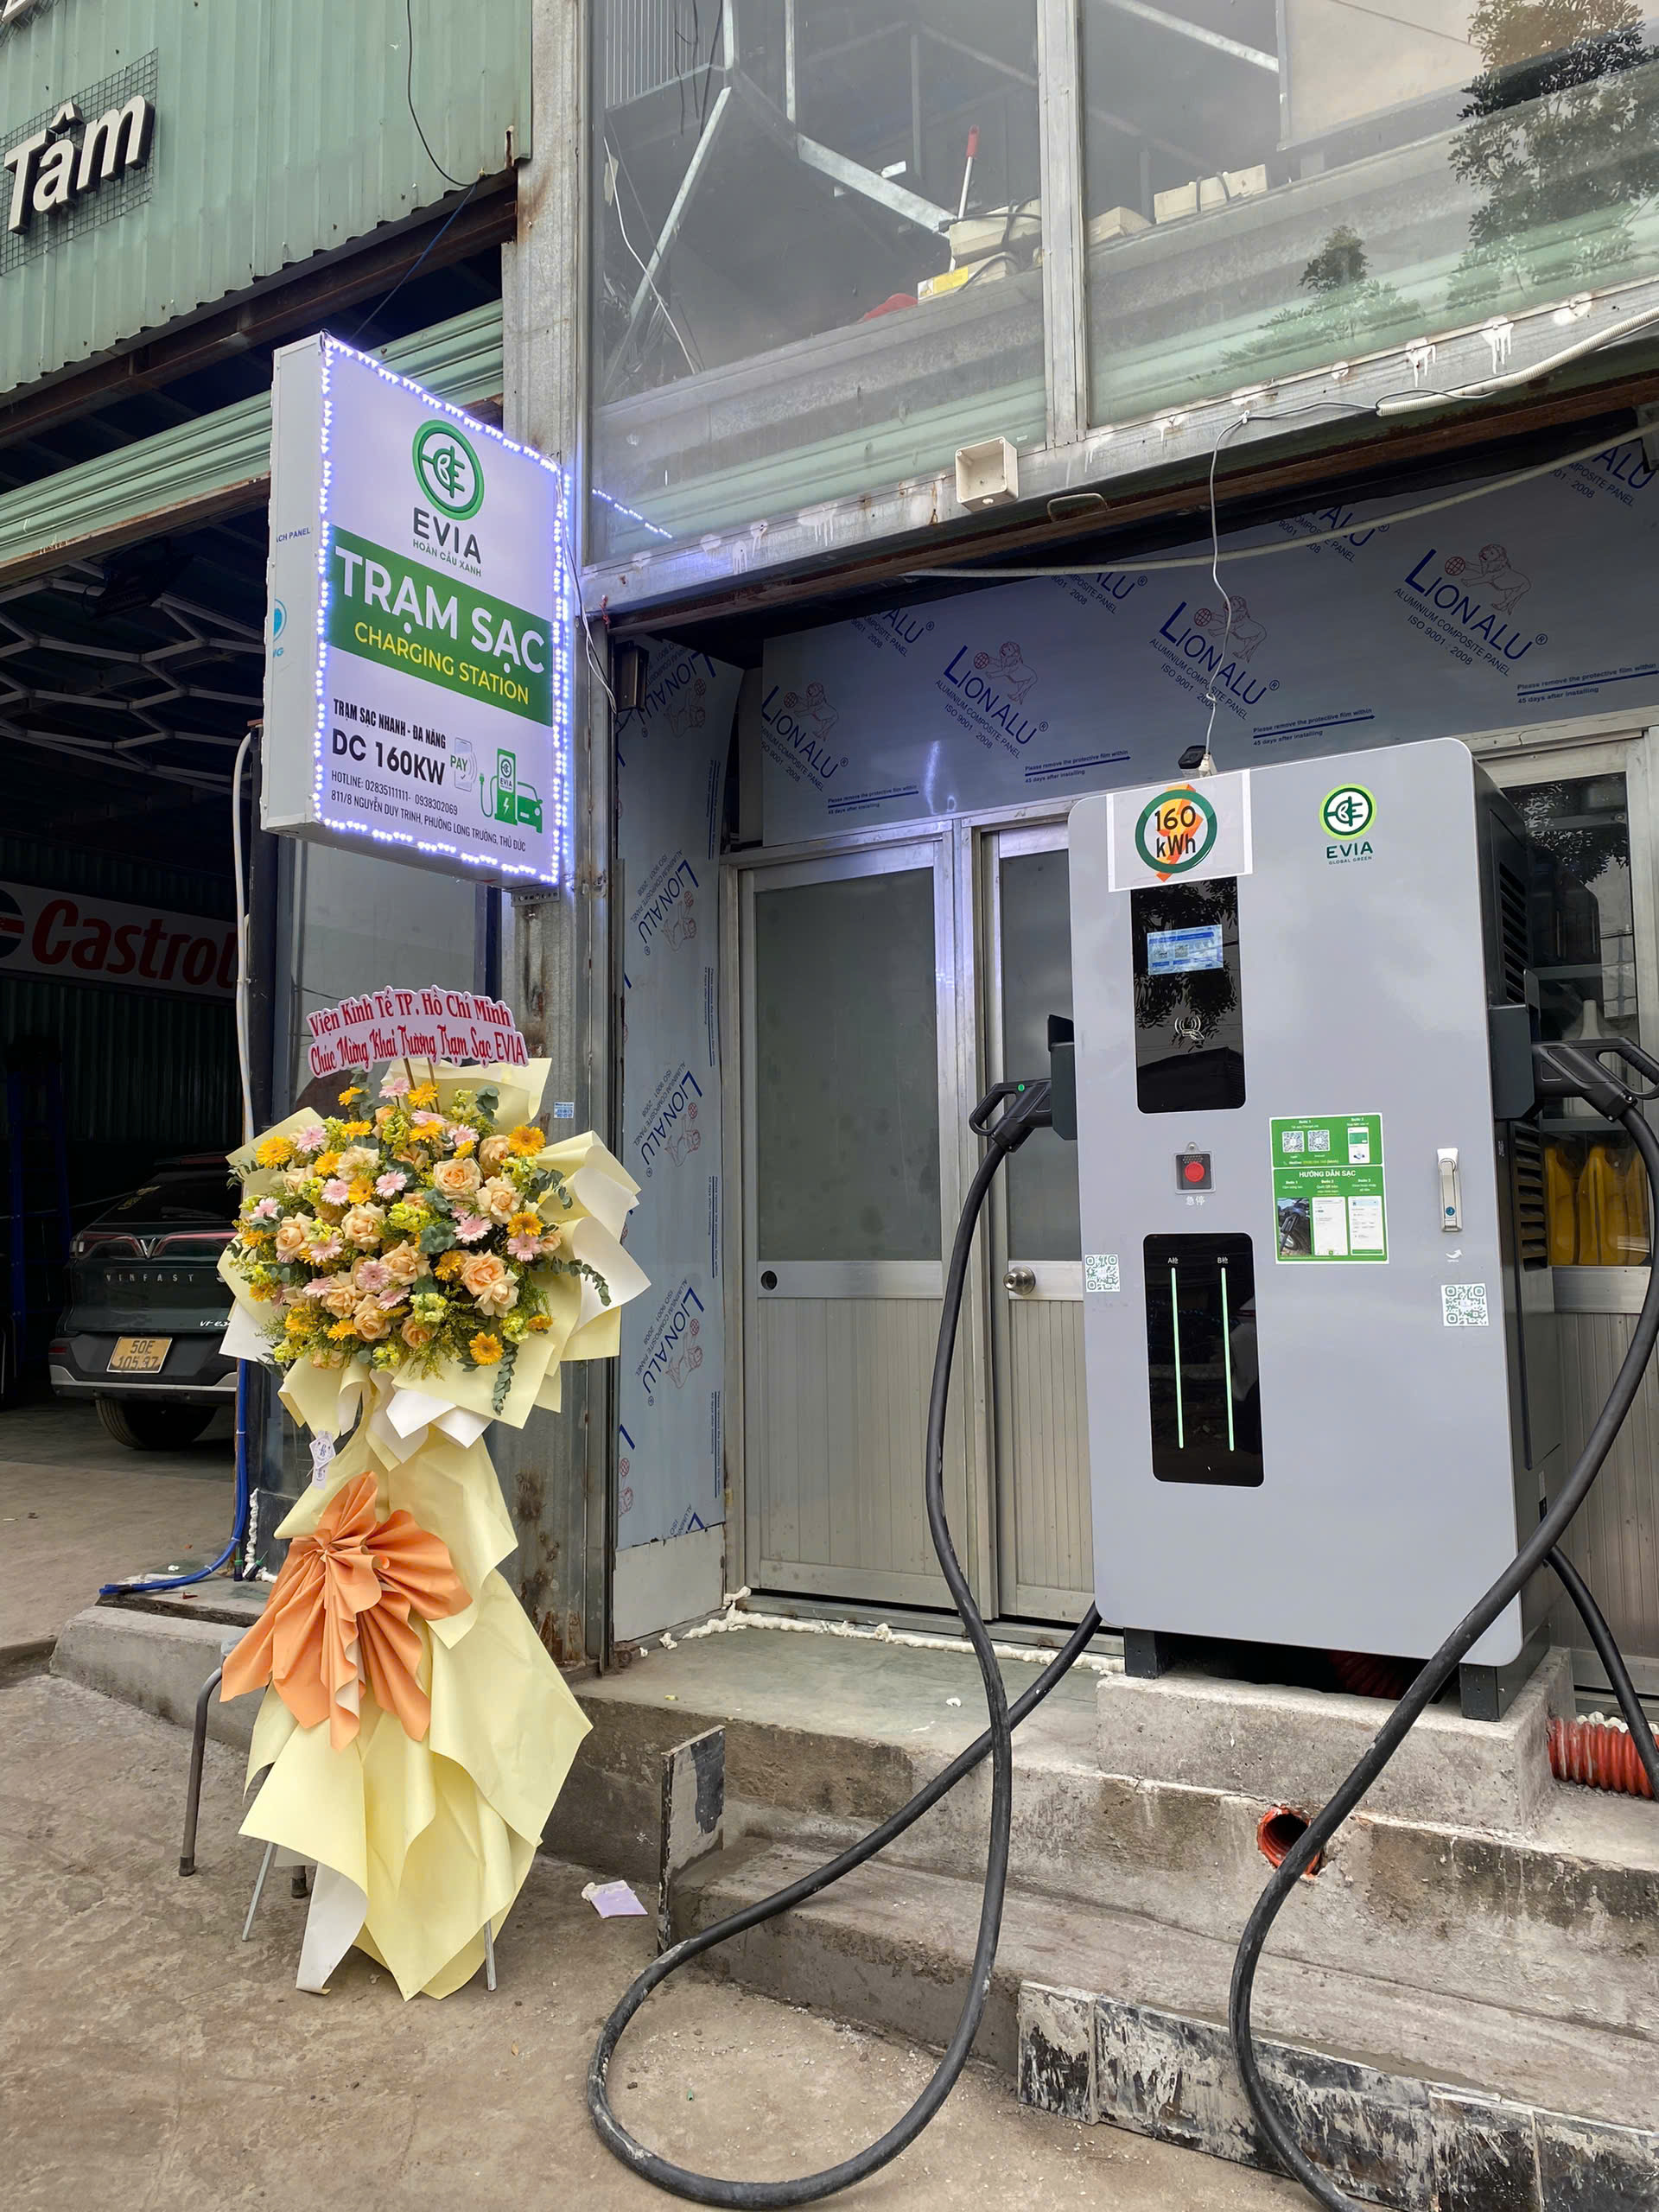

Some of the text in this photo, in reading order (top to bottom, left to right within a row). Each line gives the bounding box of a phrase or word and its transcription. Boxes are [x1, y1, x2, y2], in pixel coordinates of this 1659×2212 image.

[4, 95, 154, 234] Tâm
[1606, 483, 1635, 506] PANEL
[289, 527, 311, 540] PANEL
[414, 507, 481, 563] EVIA
[1331, 541, 1356, 563] PANEL
[413, 539, 482, 578] HOÀN CẦU XANH
[334, 545, 545, 674] TRẠM SẠC
[1070, 588, 1088, 606] 2008
[1095, 593, 1118, 615] PANEL
[1404, 548, 1534, 660] LIONALU
[1159, 601, 1268, 705] LIONALU
[1394, 588, 1511, 677] ALUMINIUM COMPOSITE PANEL
[1407, 614, 1474, 666] ISO 9001 2008
[354, 621, 530, 705] CHARGING STATION
[1149, 638, 1188, 672] ALUMINIUM
[1224, 697, 1250, 721] PANEL
[1160, 663, 1177, 678] ISO
[1175, 675, 1195, 693] 9001
[1541, 677, 1567, 687] remove
[1581, 670, 1618, 681] protective
[1618, 666, 1633, 675] film
[1634, 663, 1656, 671] within
[943, 645, 1038, 745] LIONALU
[1528, 695, 1546, 703] days
[1547, 691, 1564, 700] after
[1565, 686, 1599, 697] installing
[334, 698, 358, 721] TRẠM
[359, 707, 377, 728] SẠC
[378, 713, 406, 737] NHANH
[412, 724, 424, 743] ĐA
[761, 684, 839, 779] LIONALU
[935, 679, 1021, 760] ALUMINIUM COMPOSITE PANEL
[944, 703, 994, 750] ISO 9001 2008
[1262, 737, 1277, 746] days
[1278, 734, 1293, 743] after
[1294, 729, 1324, 741] installing
[1274, 721, 1296, 730] remove
[1308, 714, 1338, 724] protective
[1339, 710, 1352, 719] film
[332, 728, 446, 786] DC 160KW
[450, 754, 468, 772] PAY
[1100, 751, 1111, 760] film
[331, 769, 364, 789] HOTLINE:
[414, 793, 459, 817] 0938302069
[331, 789, 353, 806] 811/8
[353, 795, 383, 814] NGUYỄN
[384, 803, 399, 817] DUY
[423, 814, 453, 833] PHƯỜNG
[453, 823, 471, 838] LONG
[499, 834, 512, 849] THỦ
[512, 837, 526, 853] ĐỨC
[1154, 804, 1196, 832] 160
[1156, 833, 1196, 858] kWh
[1326, 841, 1374, 859] EVIA
[638, 859, 700, 944] LIONALU
[32, 899, 237, 989] Castrol
[309, 1011, 340, 1037] Viện
[340, 995, 375, 1027] Kinh
[374, 989, 393, 1019] Tế
[421, 988, 443, 1016] Hồ
[446, 995, 473, 1020] Chí
[474, 999, 512, 1027] Minh
[310, 1046, 337, 1077] Chúc
[336, 1036, 370, 1070] Mừng
[369, 1028, 398, 1059] Khai
[436, 1023, 469, 1064] Trạm
[470, 1026, 493, 1067] Sạc
[494, 1031, 526, 1065] EVIA
[662, 1069, 672, 1083] ISO
[640, 1070, 703, 1166] LIONALU
[1299, 1170, 1324, 1179] HƯỚNG
[1341, 1170, 1356, 1179] SẠC
[105, 1273, 195, 1282] VINFAST
[664, 1289, 674, 1304] ISO
[642, 1287, 705, 1394] LIONALU
